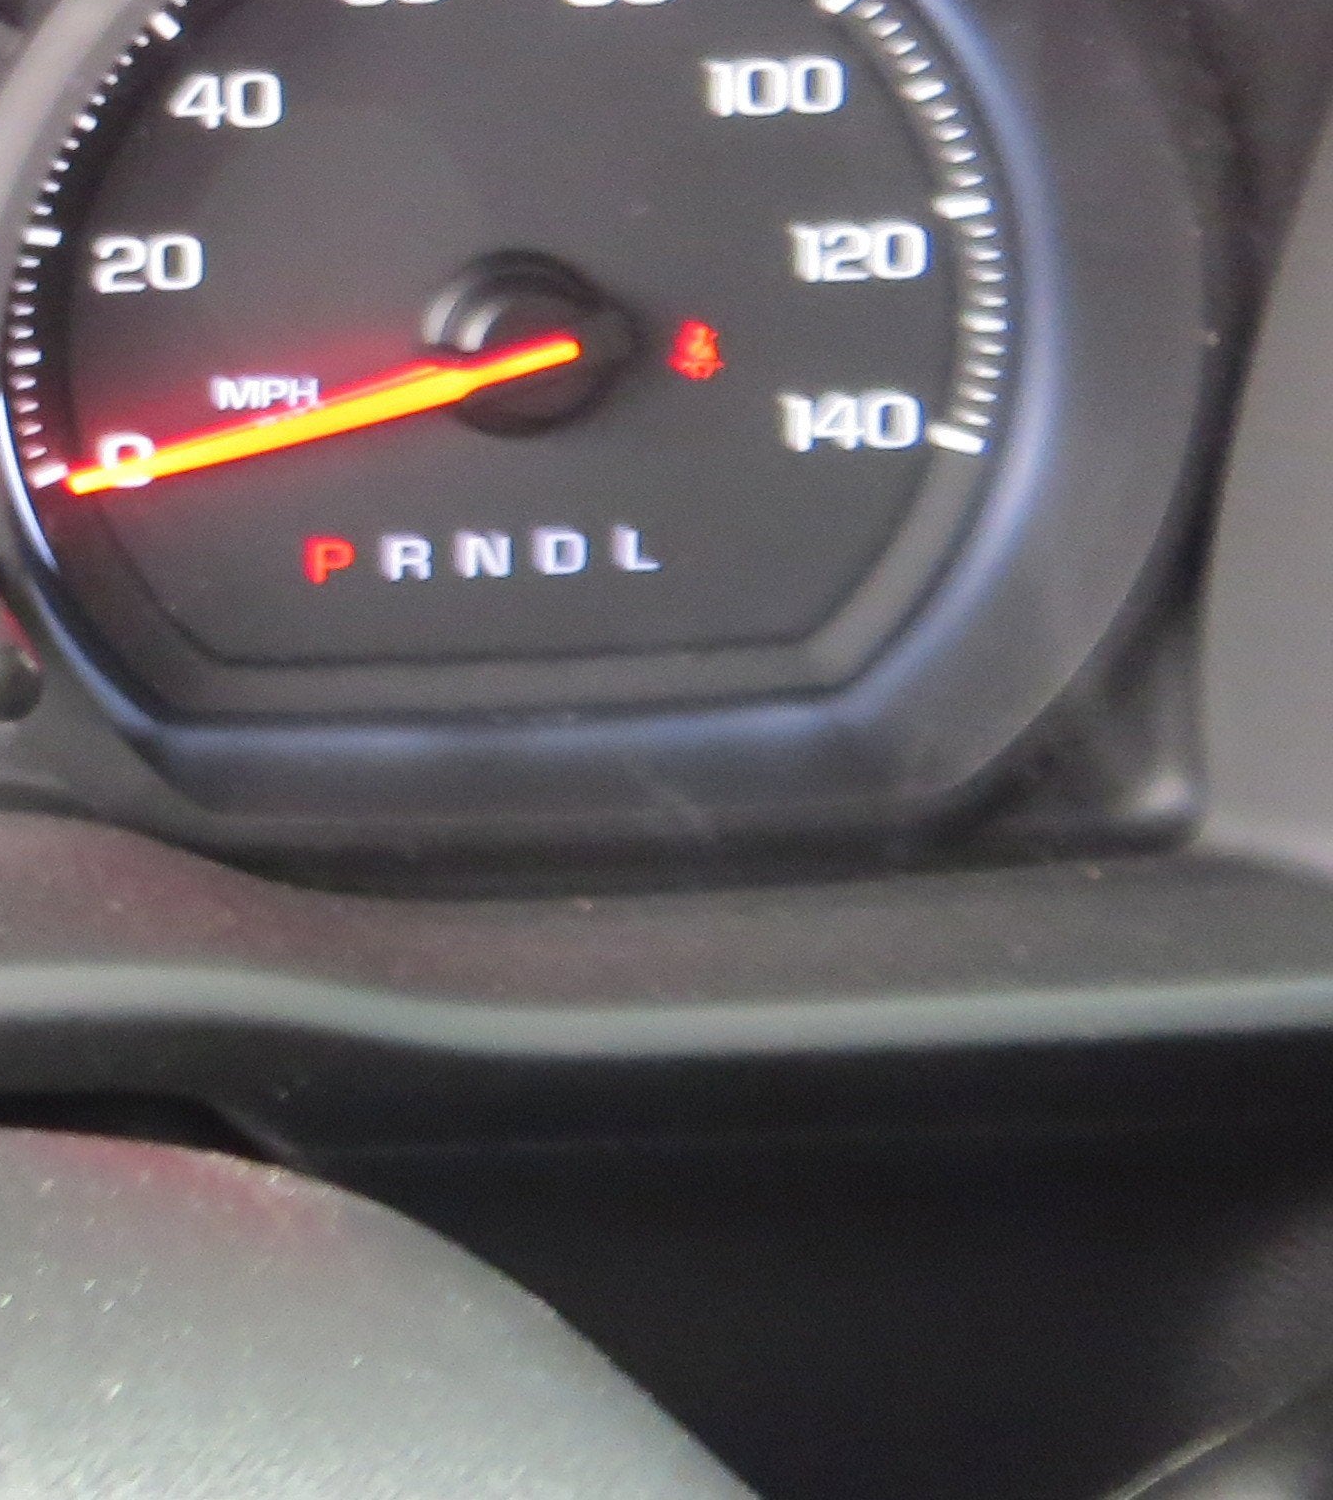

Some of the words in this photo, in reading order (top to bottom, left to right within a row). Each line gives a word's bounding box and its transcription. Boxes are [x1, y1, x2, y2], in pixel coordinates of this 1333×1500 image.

[170, 71, 282, 129] 40
[705, 56, 845, 117] 100
[94, 234, 204, 294] 20
[789, 222, 928, 282] 120
[213, 377, 320, 411] MPH
[781, 391, 921, 451] 140
[99, 432, 155, 487] 0
